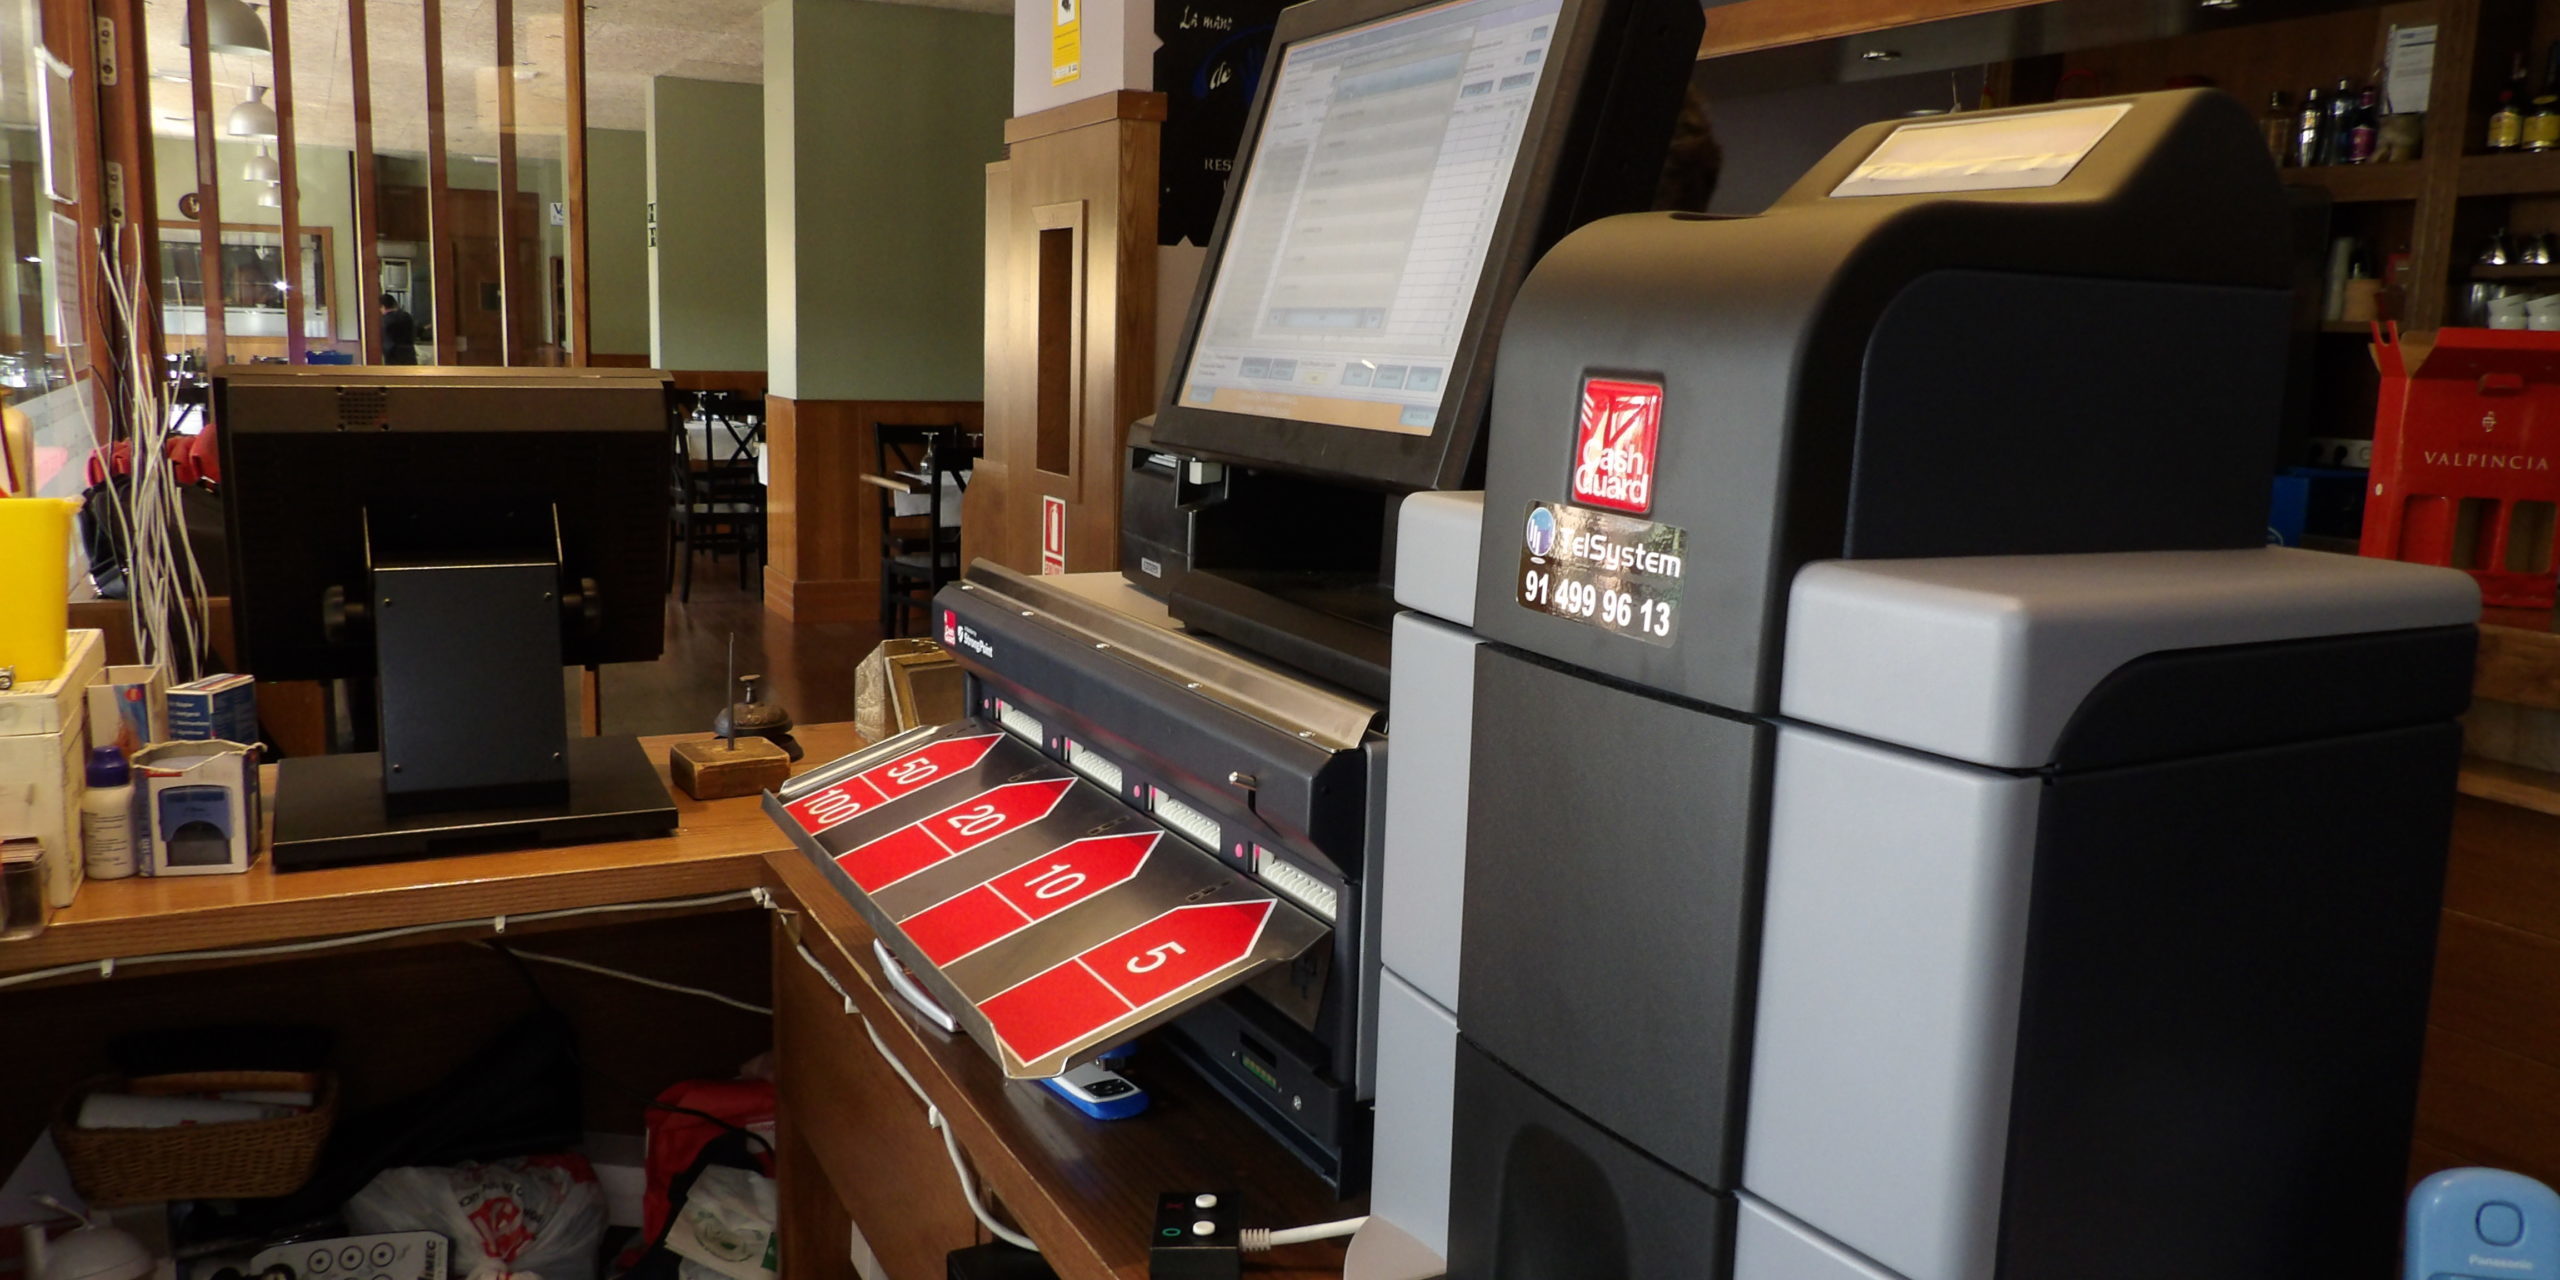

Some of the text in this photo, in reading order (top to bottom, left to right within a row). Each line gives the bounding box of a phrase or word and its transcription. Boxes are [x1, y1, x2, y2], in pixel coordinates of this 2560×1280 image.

[1180, 5, 1198, 29] La
[1209, 61, 1231, 90] de
[1583, 437, 1644, 476] Cash
[2424, 450, 2549, 471] VALPINCIA
[1576, 463, 1649, 505] Guard
[1560, 527, 1682, 579] TelSystem
[1525, 569, 1671, 637] 91 499 96 13
[887, 756, 939, 785] 50
[803, 788, 861, 825] 100
[946, 804, 1006, 837] 20
[1024, 863, 1087, 899] 10
[1126, 940, 1187, 974] 5
[2468, 1254, 2534, 1271] Panasonic
